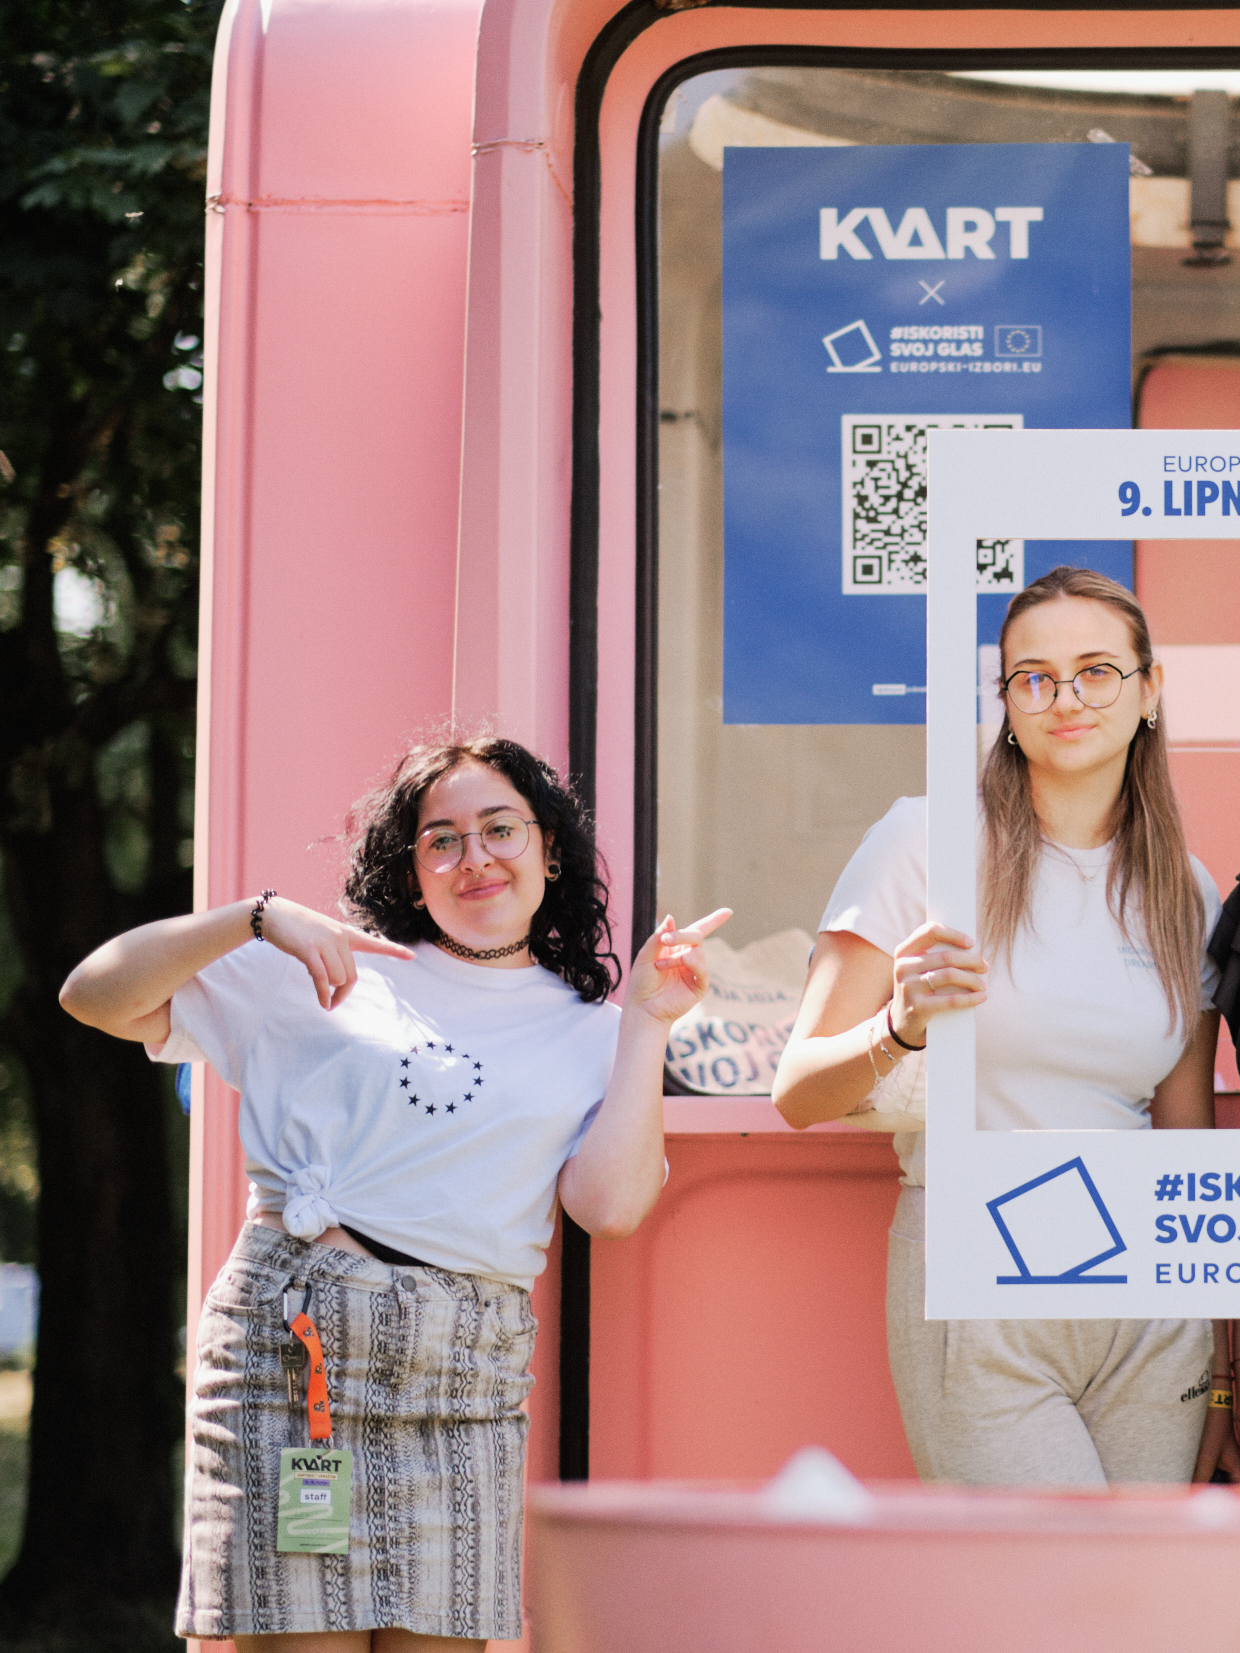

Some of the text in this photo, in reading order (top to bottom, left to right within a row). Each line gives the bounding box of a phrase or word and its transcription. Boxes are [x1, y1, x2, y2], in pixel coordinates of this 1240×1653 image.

[819, 206, 1044, 260] KVART
[889, 325, 984, 341] #ISKORISTI
[889, 342, 984, 357] SVOJ GLAS
[889, 362, 1042, 374] EUROPSKI-IZBORI.EU
[1118, 480, 1153, 517] 9.
[291, 1457, 342, 1472] KVART
[304, 1492, 327, 1500] staff
